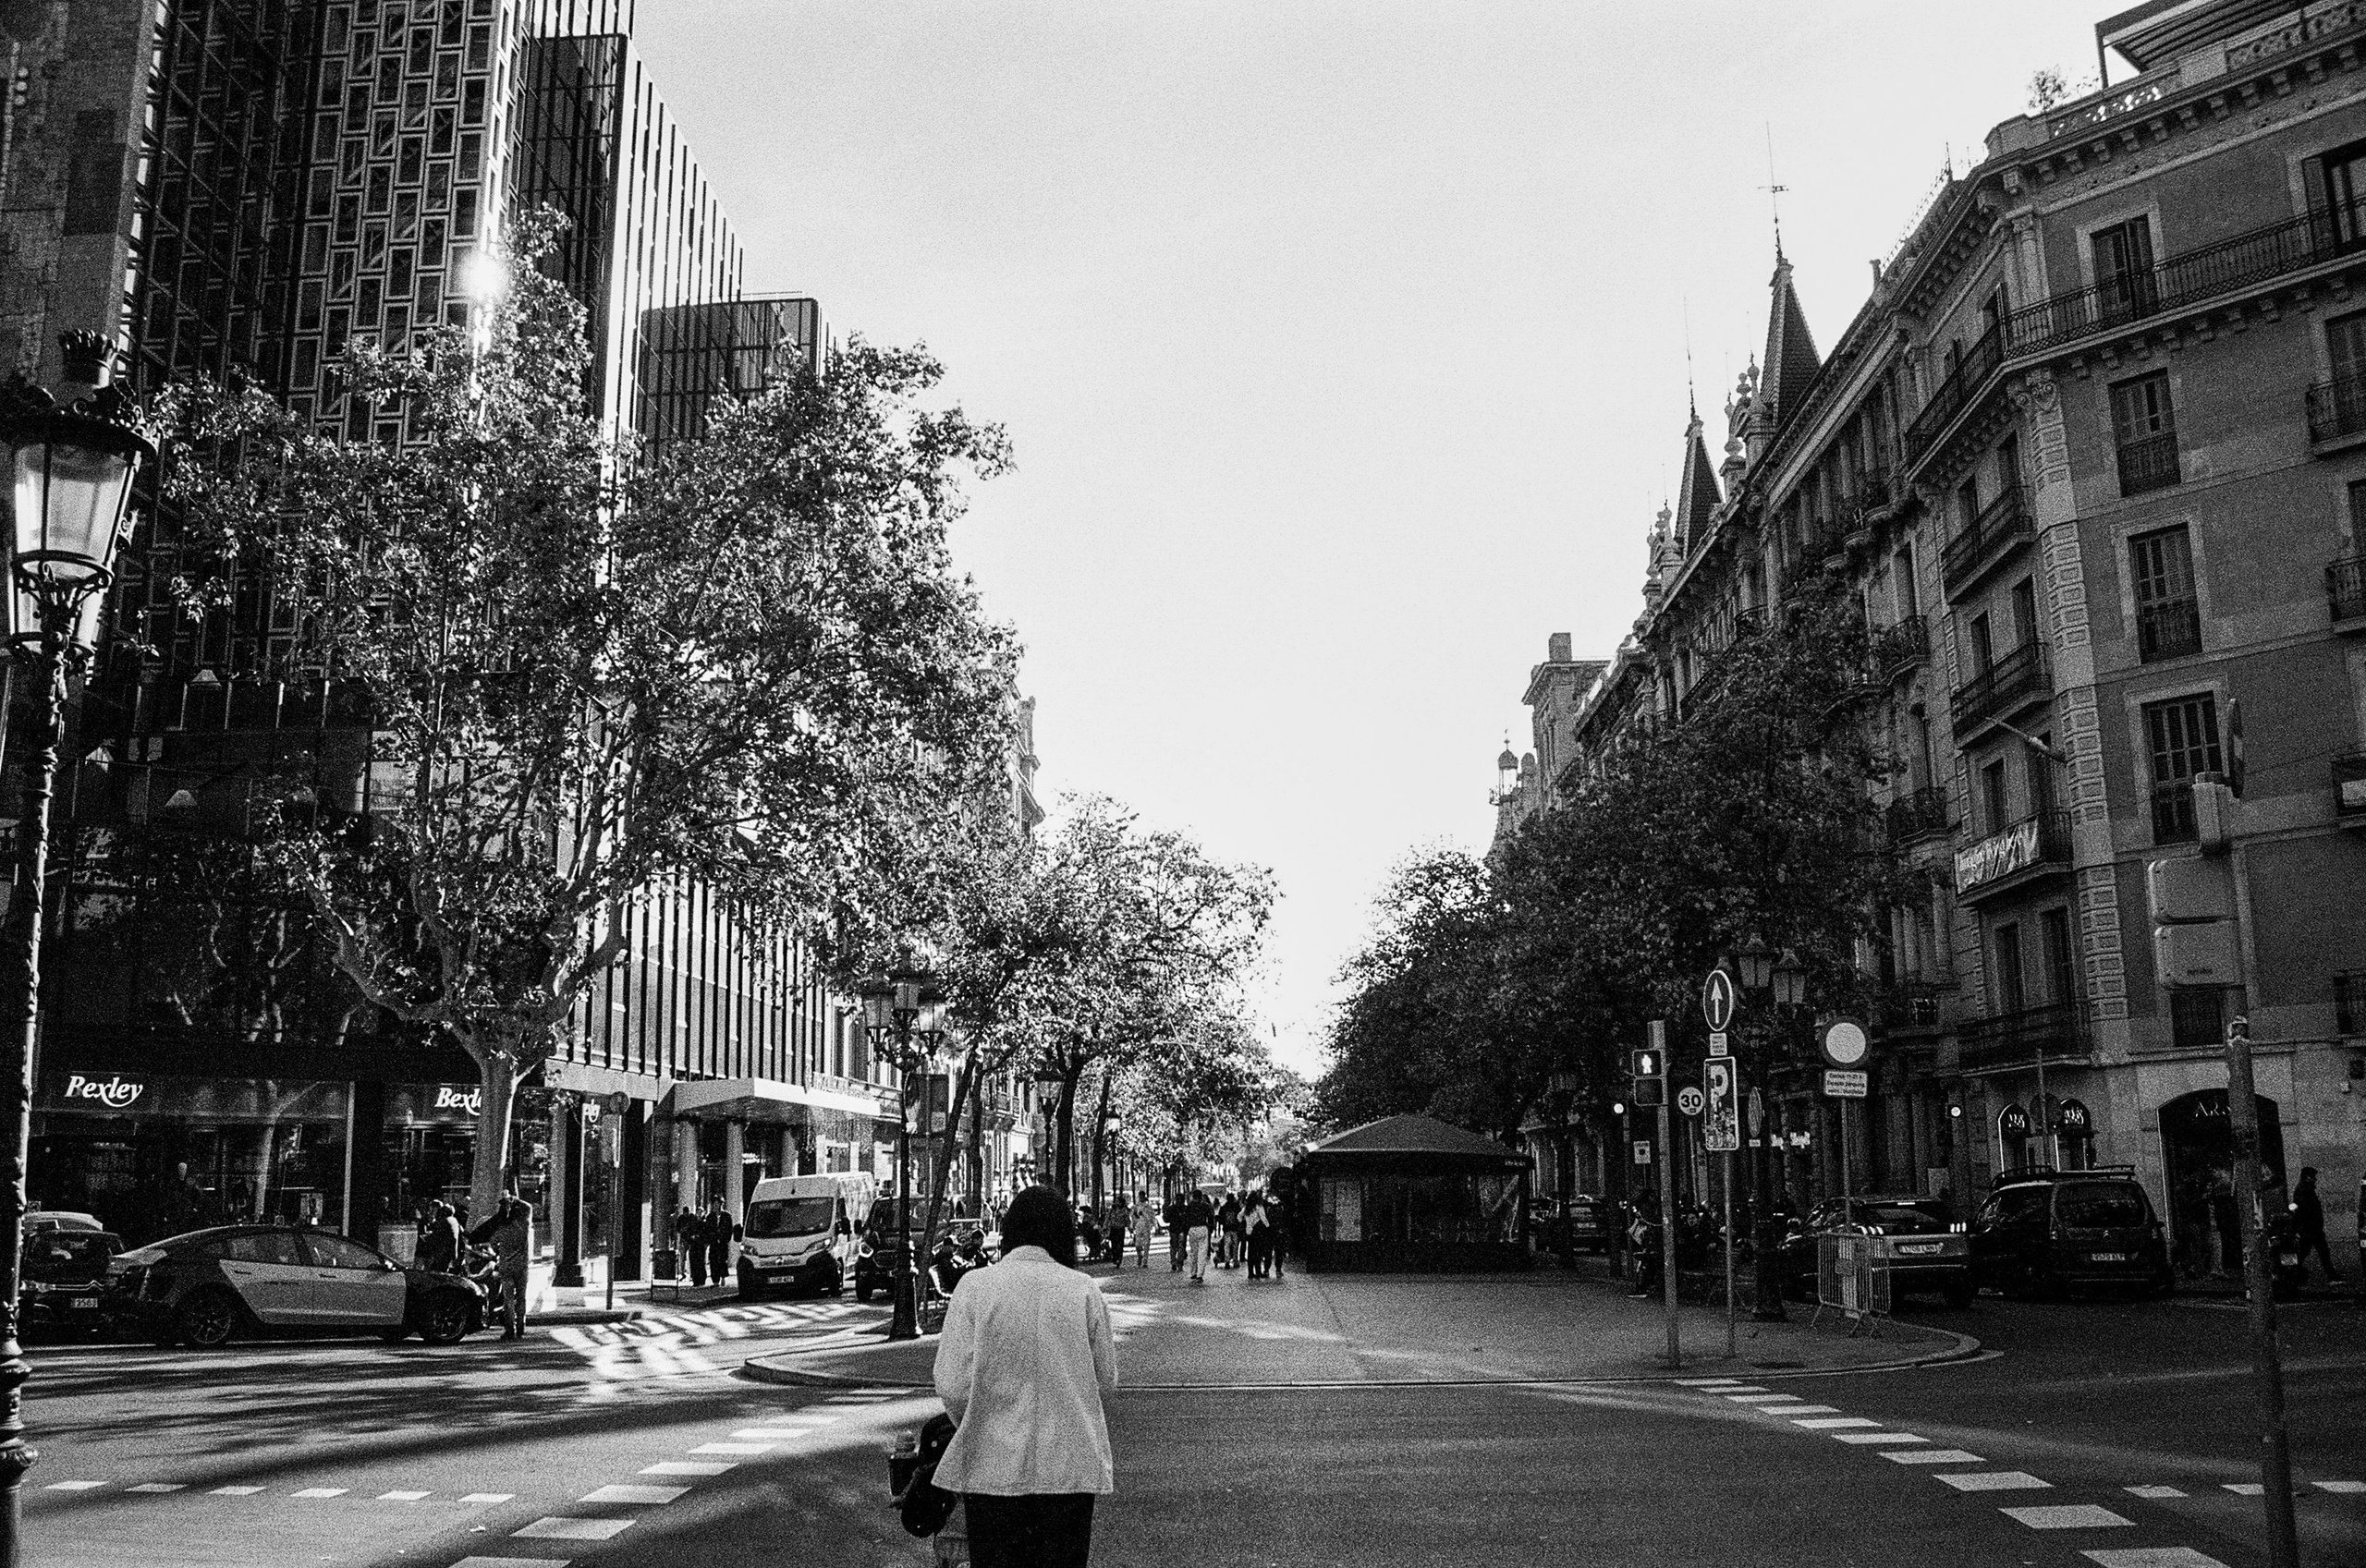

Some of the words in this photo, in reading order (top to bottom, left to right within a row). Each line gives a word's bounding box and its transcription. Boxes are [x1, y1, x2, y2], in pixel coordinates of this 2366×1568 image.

[64, 1076, 143, 1107] Bexley
[434, 1087, 482, 1116] Bexl
[1681, 1094, 1701, 1108] 30
